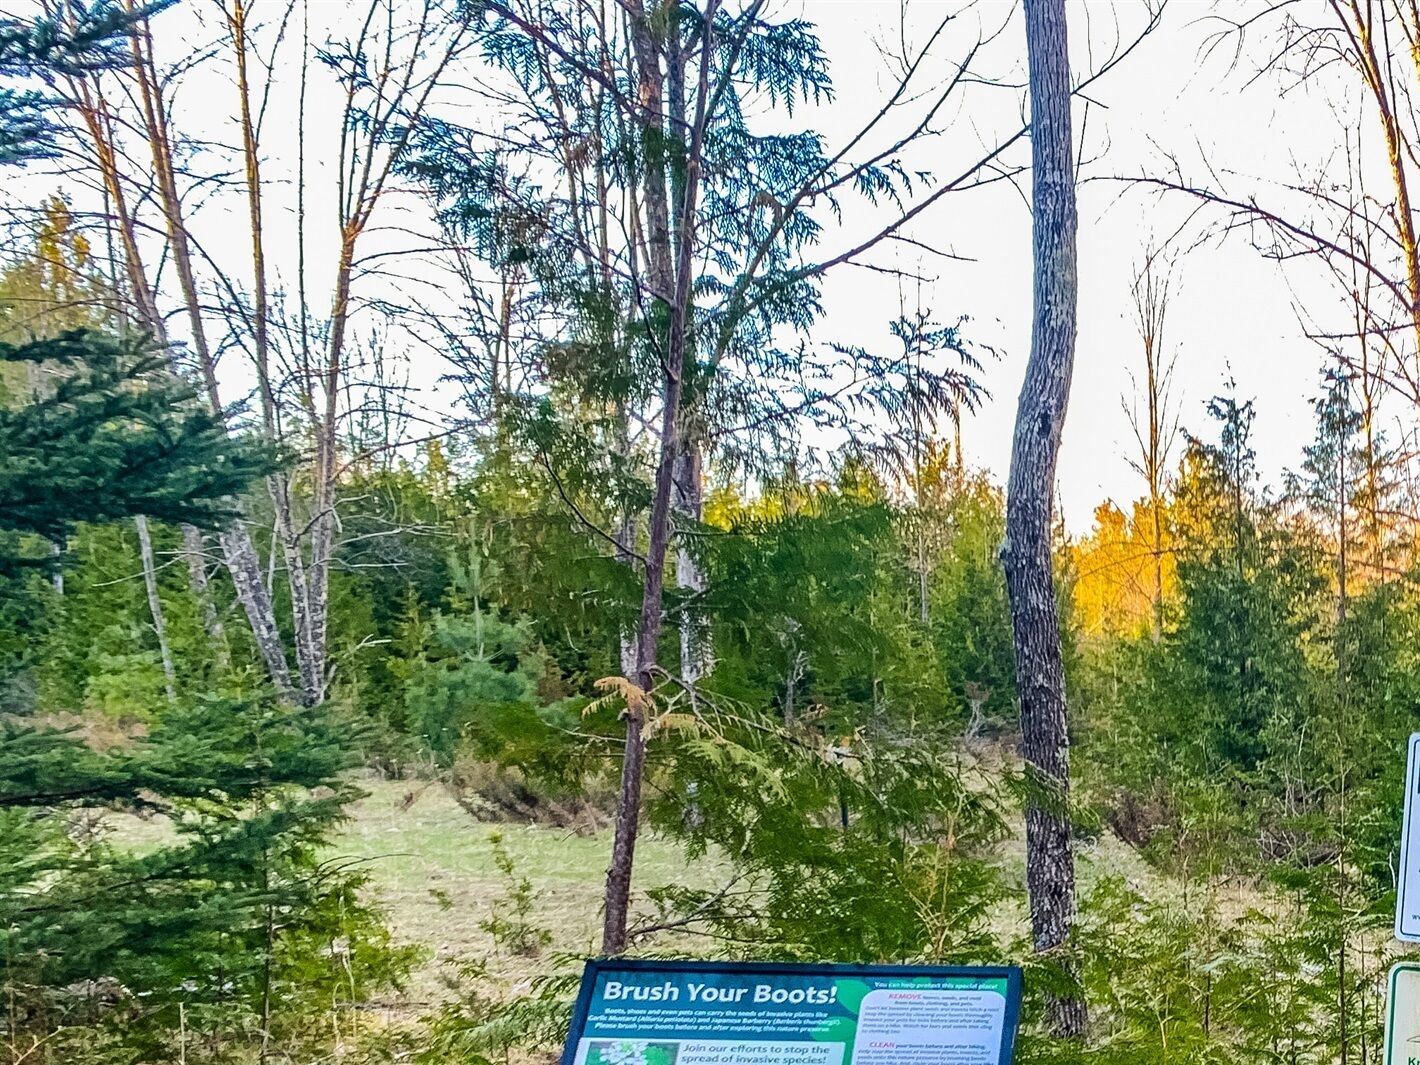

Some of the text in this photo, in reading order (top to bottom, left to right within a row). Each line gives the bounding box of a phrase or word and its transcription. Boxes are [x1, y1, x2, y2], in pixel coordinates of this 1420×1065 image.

[603, 981, 837, 1004] Brush Your Boots!
[683, 1044, 831, 1055] Join our efforts to stop the
[681, 1054, 827, 1065] spread of invasive species!
